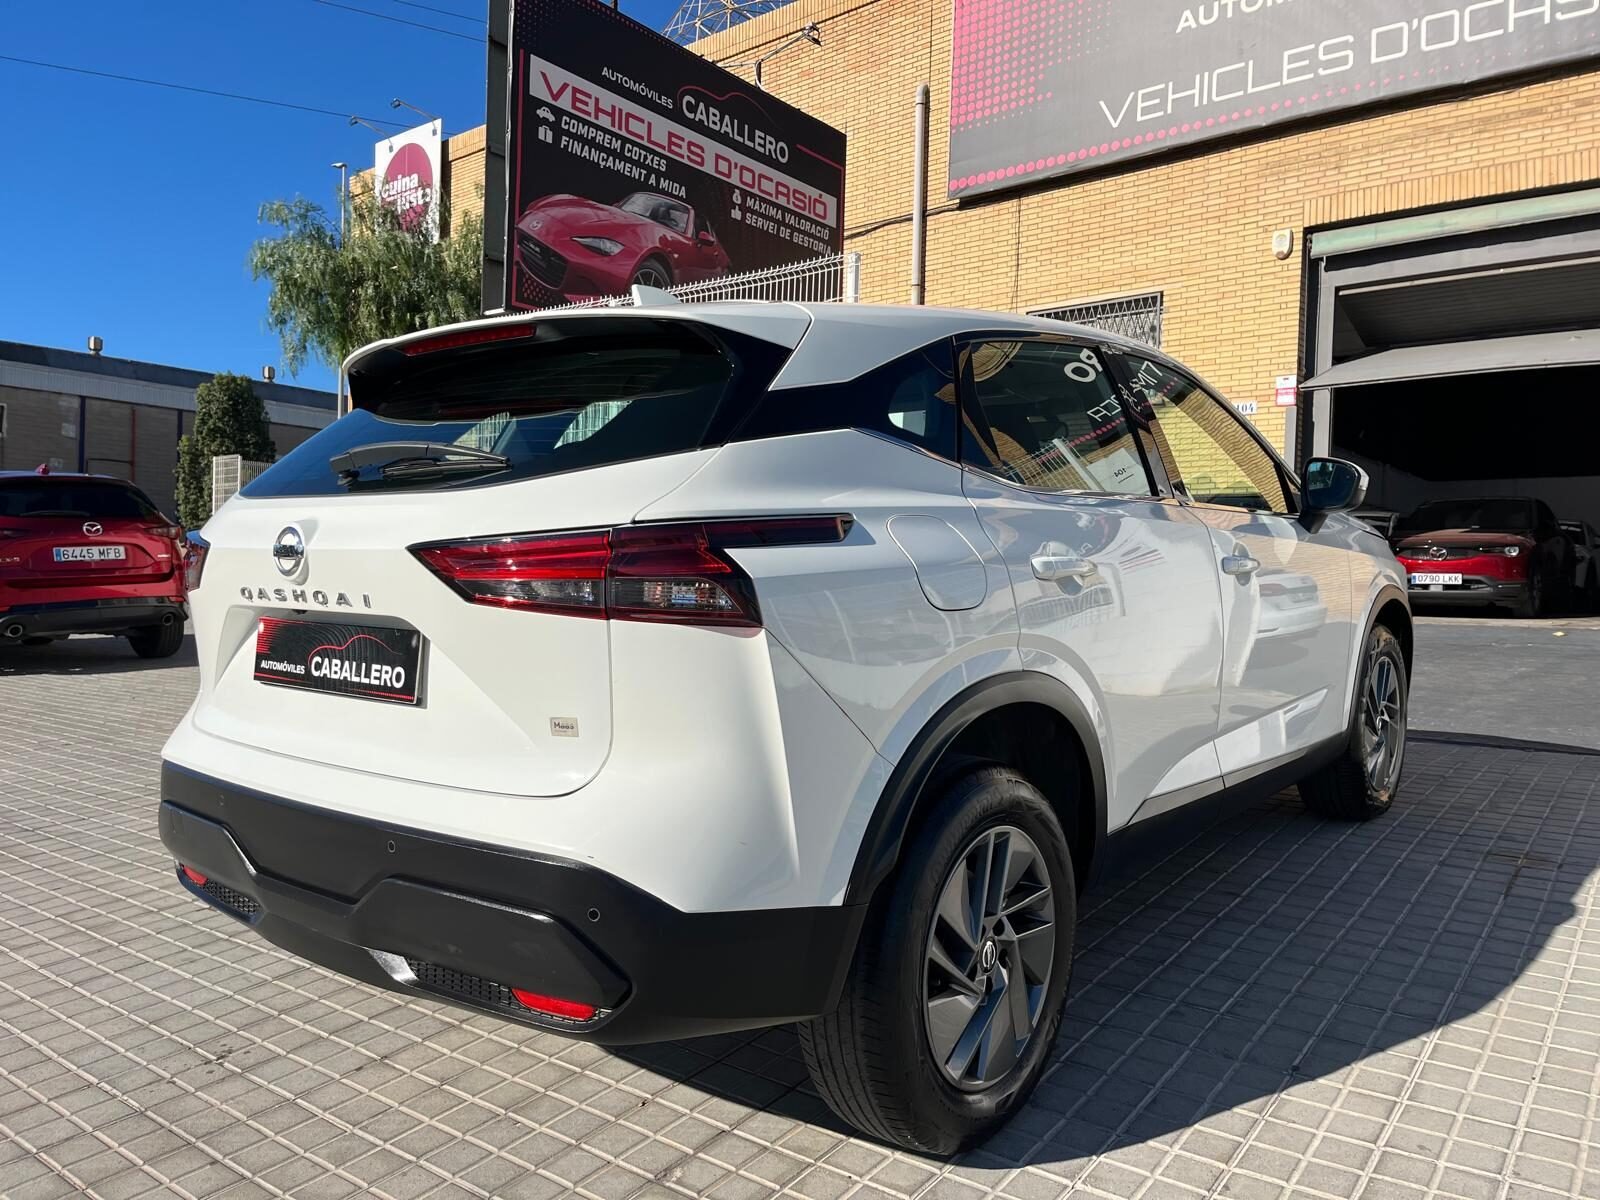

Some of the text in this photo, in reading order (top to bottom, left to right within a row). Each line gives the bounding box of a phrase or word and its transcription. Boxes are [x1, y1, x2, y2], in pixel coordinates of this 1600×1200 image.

[1175, 0, 1292, 33] AUTO
[1099, 40, 1354, 128] VEHICLES
[601, 66, 789, 164] AUTOMÓVILES CABALLERO
[540, 70, 828, 221] VEHICLES D'OCASIÓ
[561, 115, 667, 172] COMPREM COTXES
[381, 173, 419, 199] cuina
[560, 136, 687, 199] FINANÇAMENT A MIDA
[745, 213, 832, 257] SERVEI DE GESTORIA
[746, 196, 830, 240] MÀXIMA VALORACIÓ
[62, 547, 122, 560] 6445 MFB
[240, 586, 372, 609] QASHQAI
[1417, 574, 1460, 583] 0790 LKK
[260, 655, 405, 689] AUTOMÓVILES CABALLERO
